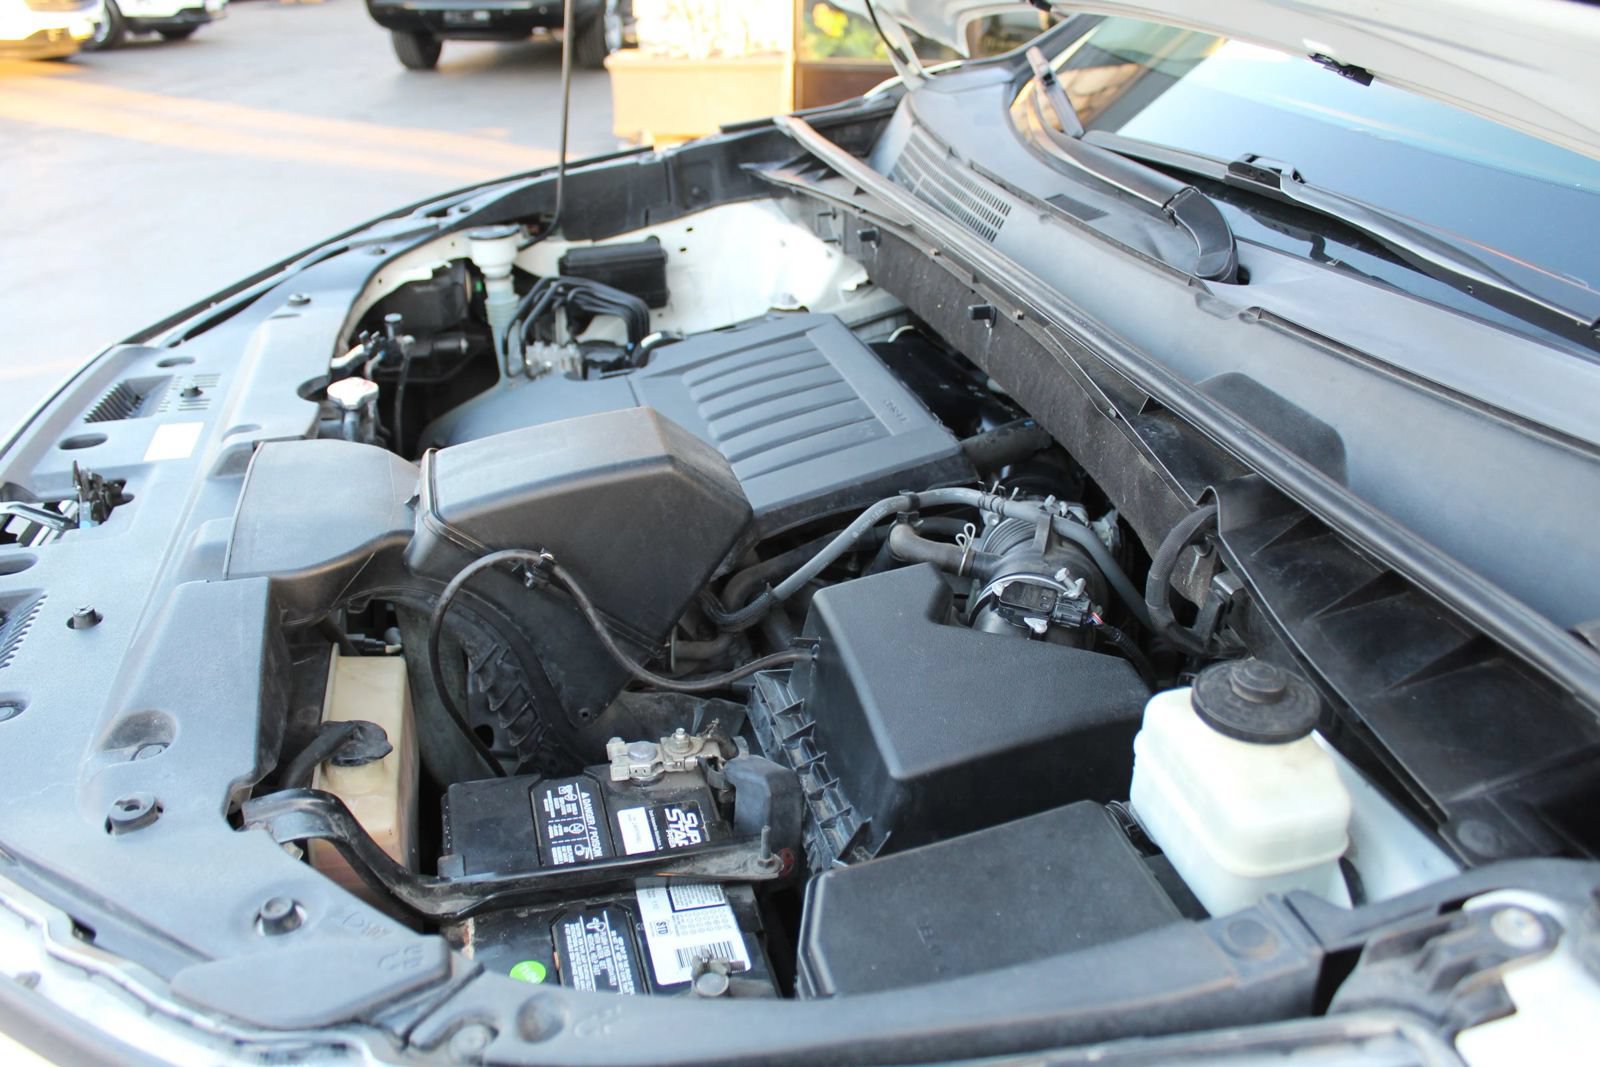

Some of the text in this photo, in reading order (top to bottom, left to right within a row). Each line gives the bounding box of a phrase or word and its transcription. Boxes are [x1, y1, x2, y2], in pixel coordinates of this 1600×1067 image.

[583, 799, 596, 825] DANGER
[590, 831, 602, 857] POISON
[656, 921, 669, 935] STD
